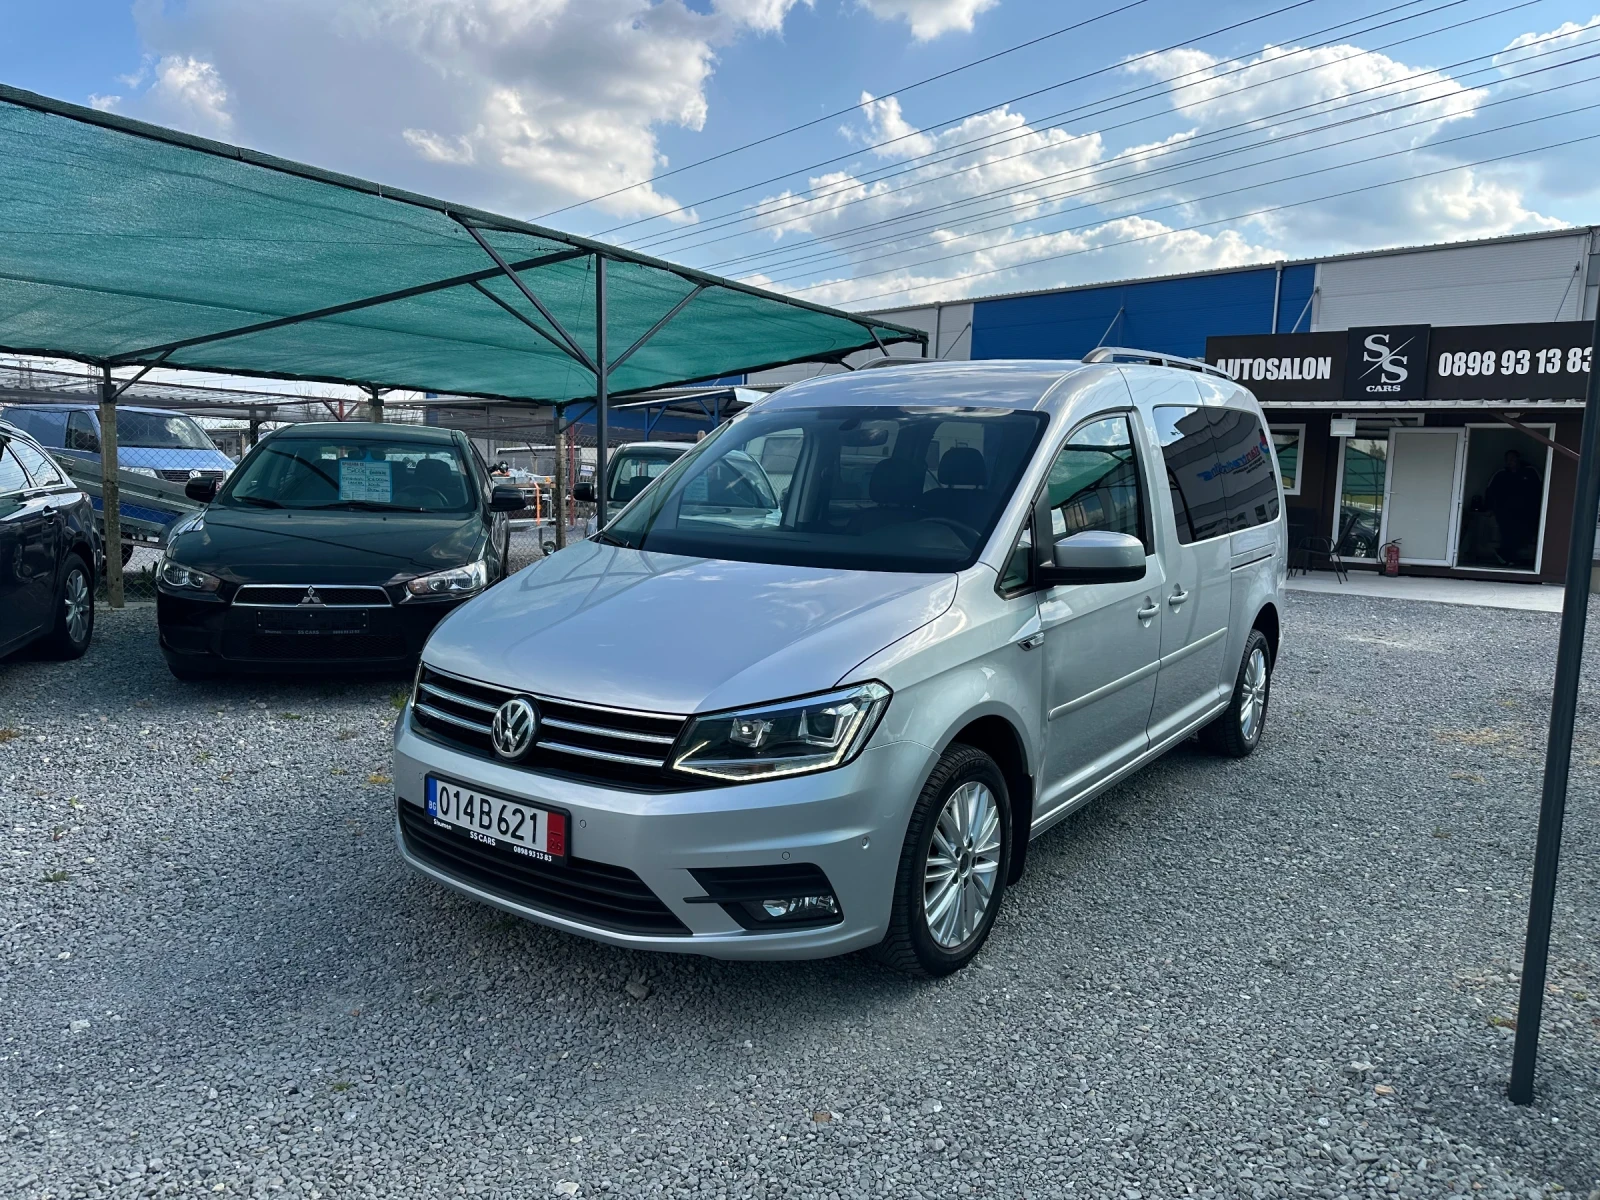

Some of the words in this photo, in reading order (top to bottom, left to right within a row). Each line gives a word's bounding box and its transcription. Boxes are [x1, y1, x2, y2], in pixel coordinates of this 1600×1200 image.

[1216, 357, 1332, 381] AUTOSALON
[1438, 351, 1496, 376] 0898
[1500, 350, 1531, 375] 93
[1536, 348, 1562, 373] 13
[1366, 384, 1401, 392] CARS
[428, 800, 437, 811] BG
[470, 831, 478, 840] SS
[478, 834, 496, 847] CARS
[513, 845, 528, 856] 0898
[528, 849, 536, 858] 93
